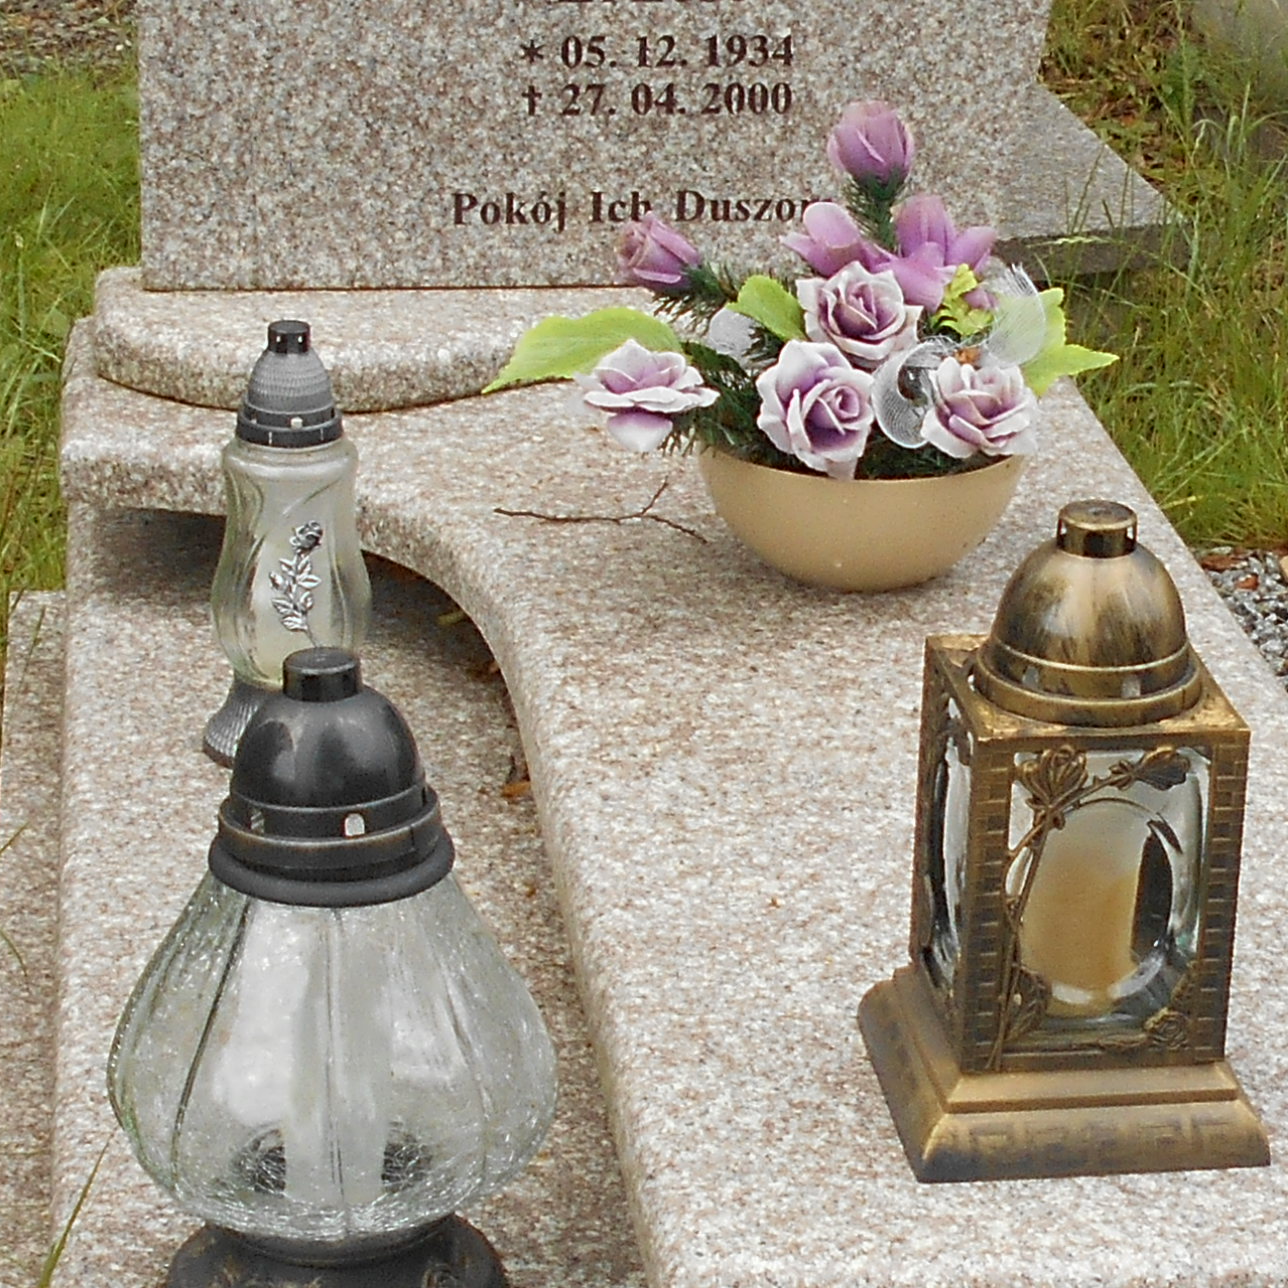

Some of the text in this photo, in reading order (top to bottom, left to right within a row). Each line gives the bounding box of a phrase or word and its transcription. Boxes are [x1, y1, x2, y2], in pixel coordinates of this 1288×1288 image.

[560, 33, 795, 69] 05. 12. 1934
[560, 82, 793, 117] 27. 04. 2000
[453, 191, 568, 233] Pokój
[590, 190, 653, 224] Ich
